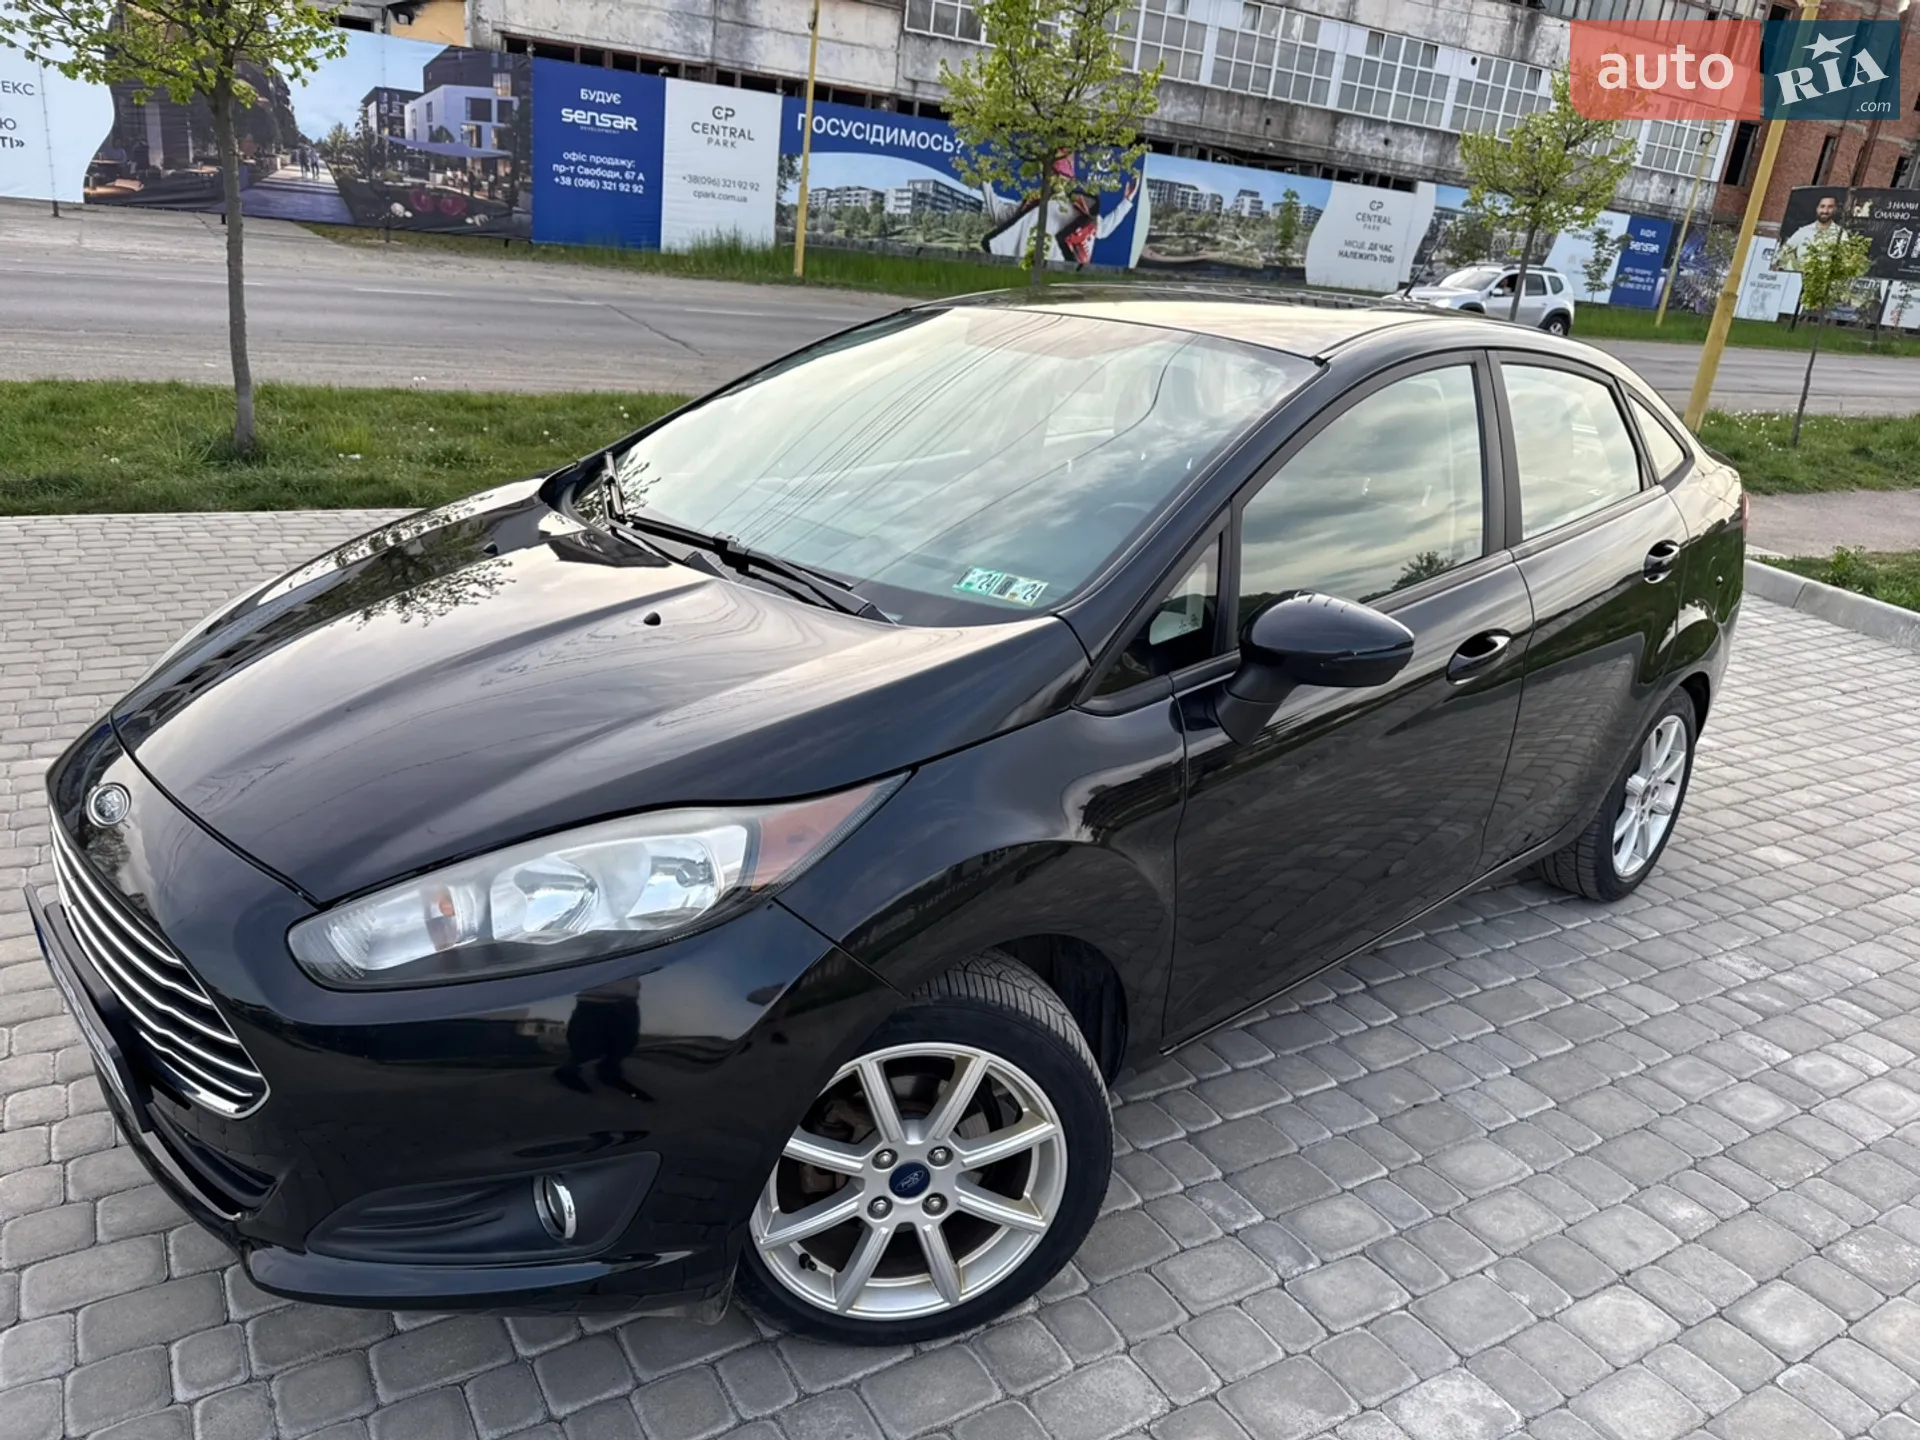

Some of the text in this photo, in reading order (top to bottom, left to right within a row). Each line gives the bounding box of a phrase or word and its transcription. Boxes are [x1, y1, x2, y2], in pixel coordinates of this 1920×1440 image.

[579, 88, 621, 105] БУДУЄ
[690, 121, 755, 142] CENTRAL
[706, 136, 738, 149] PARK
[562, 151, 636, 169] офіс продажу:
[554, 175, 644, 194] +38 (096) 321 92 92
[1355, 212, 1392, 226] CENTRAL
